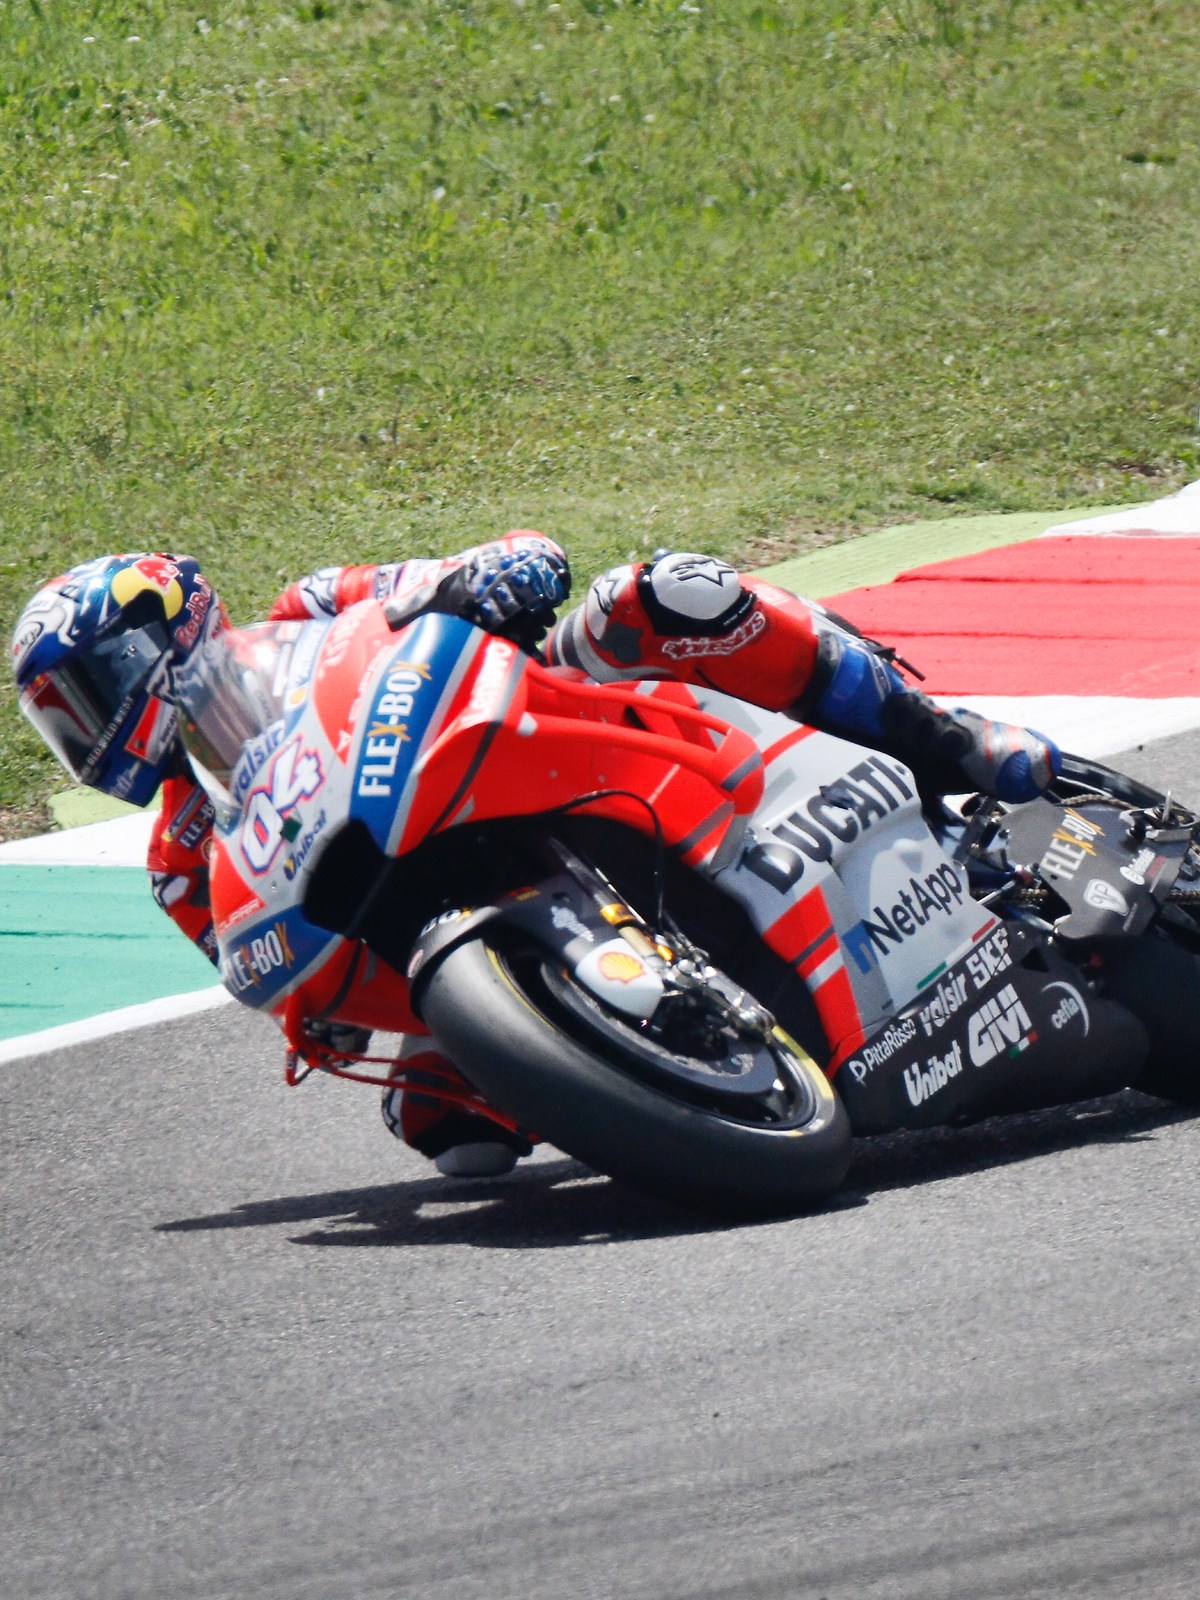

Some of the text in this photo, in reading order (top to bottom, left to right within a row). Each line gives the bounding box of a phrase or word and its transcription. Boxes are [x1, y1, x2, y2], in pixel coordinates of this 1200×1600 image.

[357, 660, 432, 797] FLEX-BOX
[242, 735, 326, 876] 04
[743, 755, 915, 896] DUCATI
[861, 862, 964, 956] NetApp
[965, 926, 1014, 991] SKF
[862, 1017, 918, 1072] PittaRosso
[918, 970, 970, 1037] valsir
[968, 982, 1033, 1068] GIVI
[903, 1039, 964, 1107] Unibat
